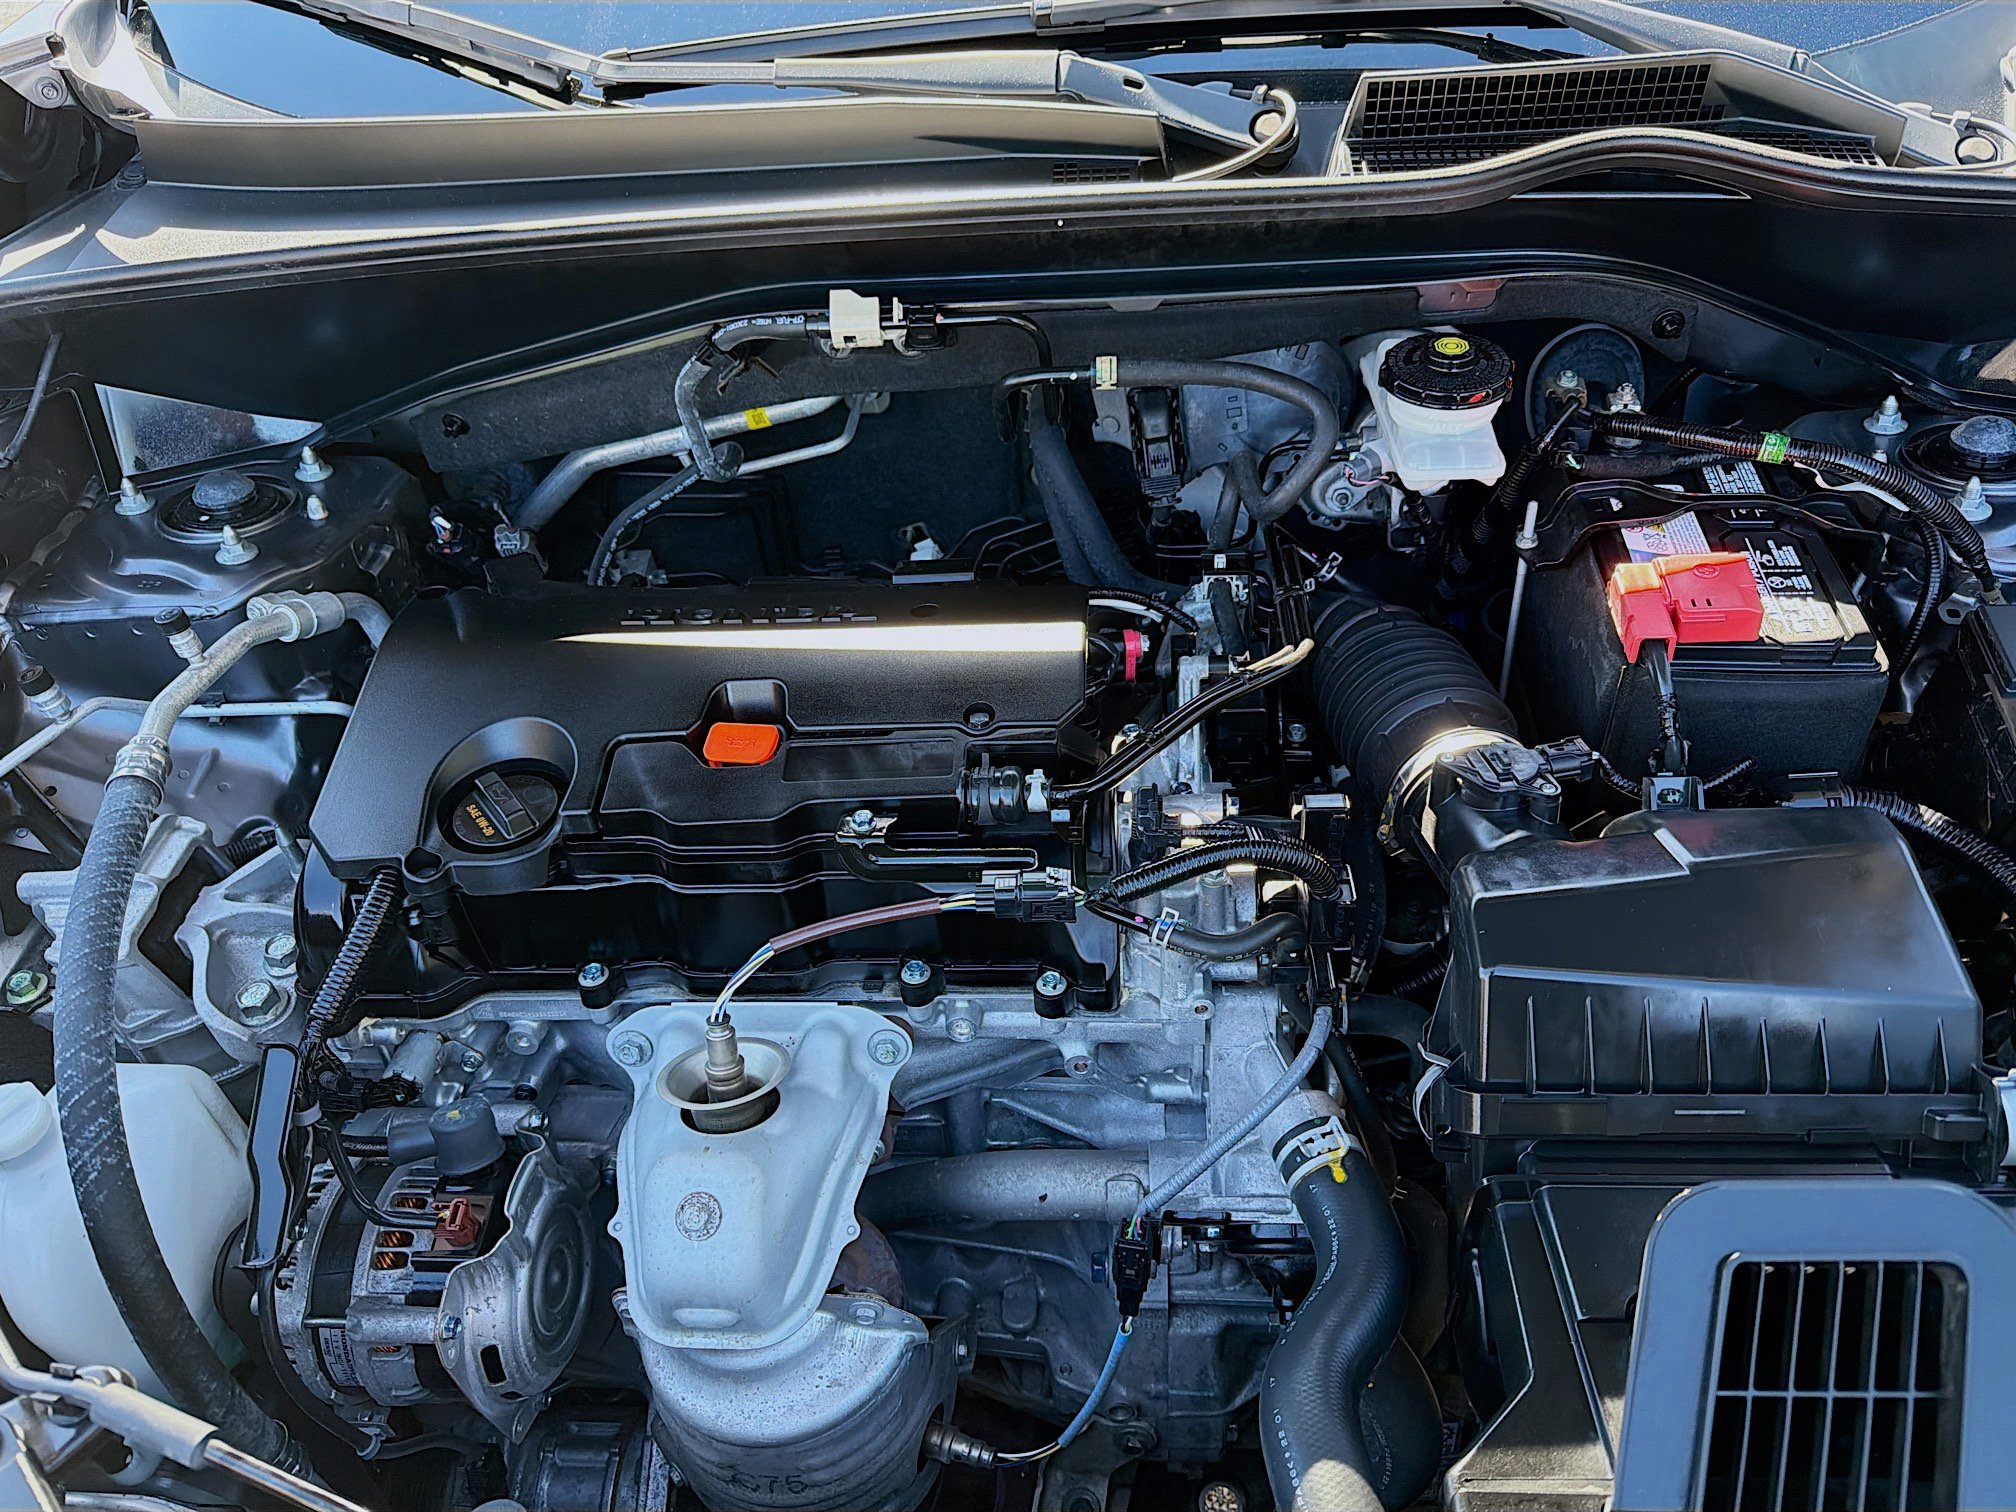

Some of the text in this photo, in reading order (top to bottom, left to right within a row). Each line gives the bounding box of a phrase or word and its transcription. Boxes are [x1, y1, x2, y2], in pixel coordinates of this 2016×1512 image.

[466, 804, 495, 837] SAE 0W-20
[1327, 1218, 1336, 1230] 22
[1278, 1429, 1288, 1447] 22
